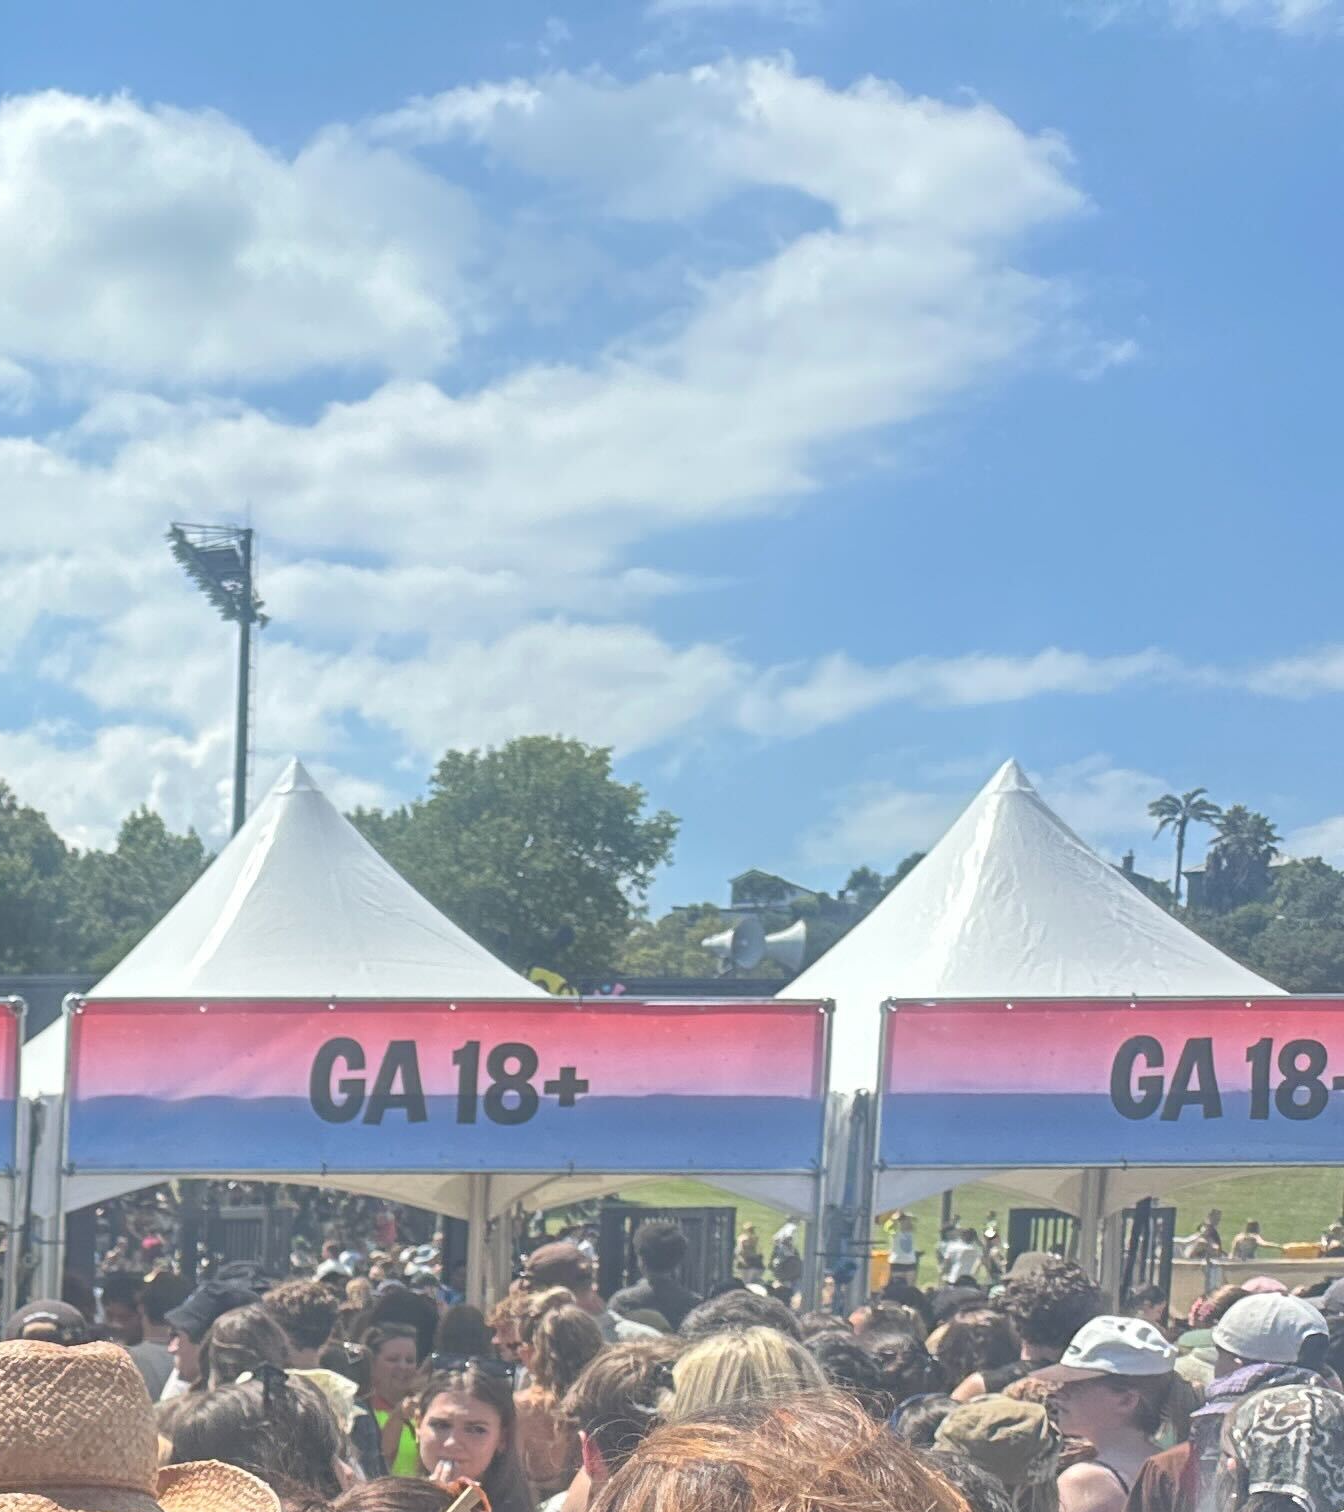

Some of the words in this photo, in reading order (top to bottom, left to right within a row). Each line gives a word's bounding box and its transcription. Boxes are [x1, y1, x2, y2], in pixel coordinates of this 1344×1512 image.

[309, 1036, 428, 1125] GA
[452, 1040, 589, 1125] 18+
[1110, 1035, 1223, 1121] GA
[1246, 1037, 1344, 1121] 18
